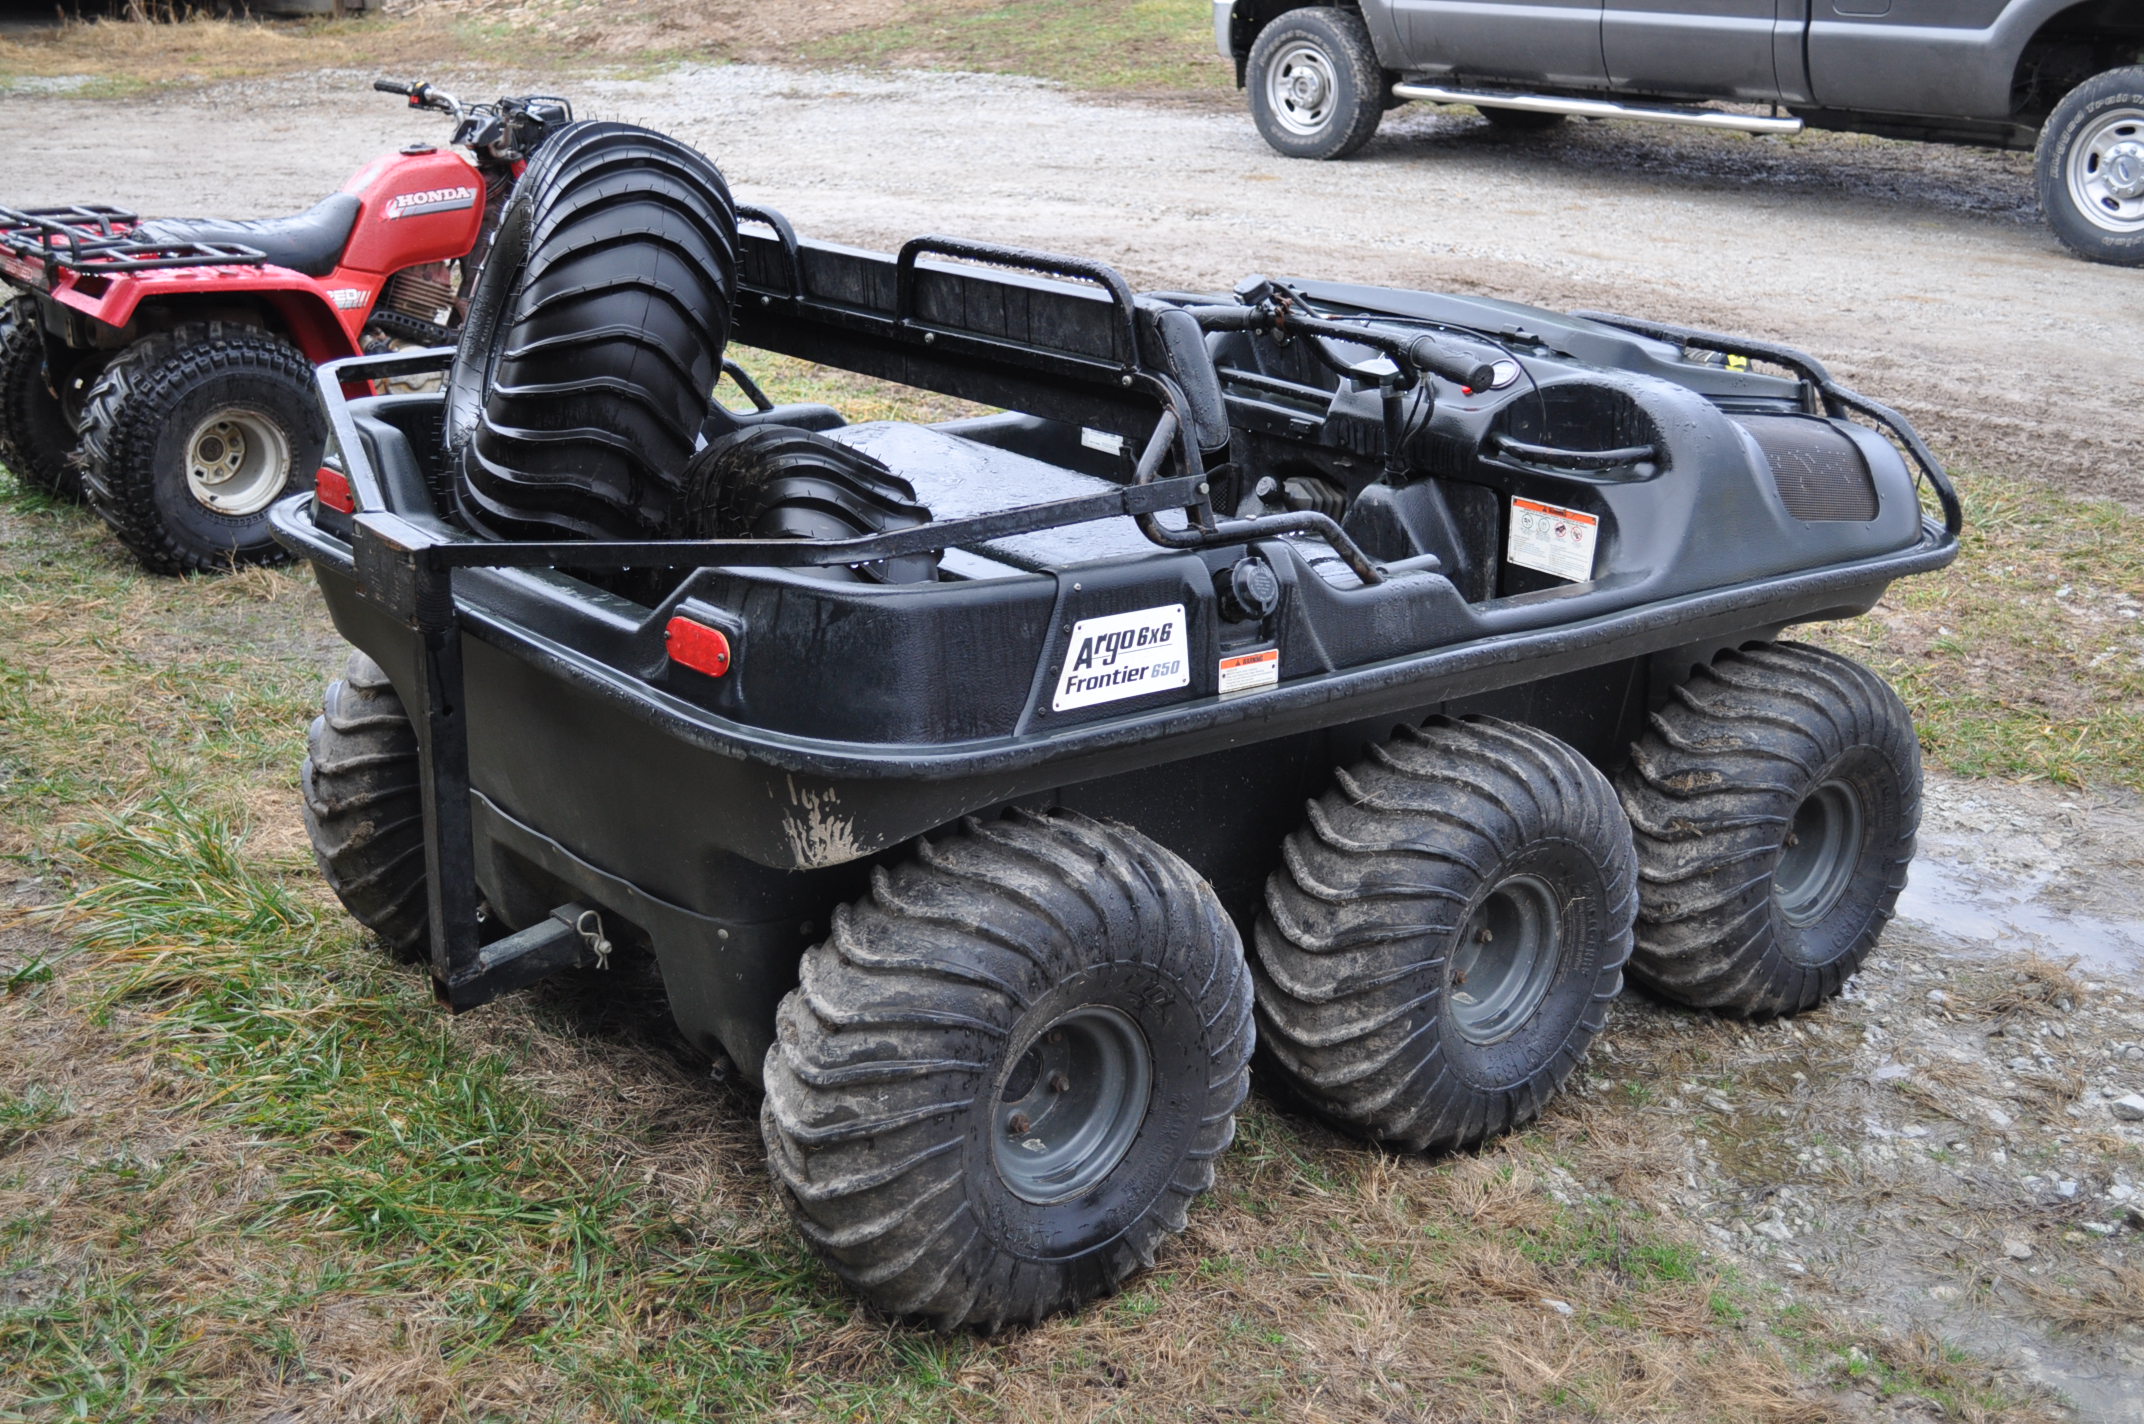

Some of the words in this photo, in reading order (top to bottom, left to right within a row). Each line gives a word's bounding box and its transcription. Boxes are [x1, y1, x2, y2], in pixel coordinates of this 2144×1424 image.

[2049, 110, 2085, 179] Rugged
[2085, 93, 2129, 113] Trail
[396, 187, 471, 207] HONDA
[1065, 665, 1150, 695] Frontier
[1150, 660, 1181, 679] 650
